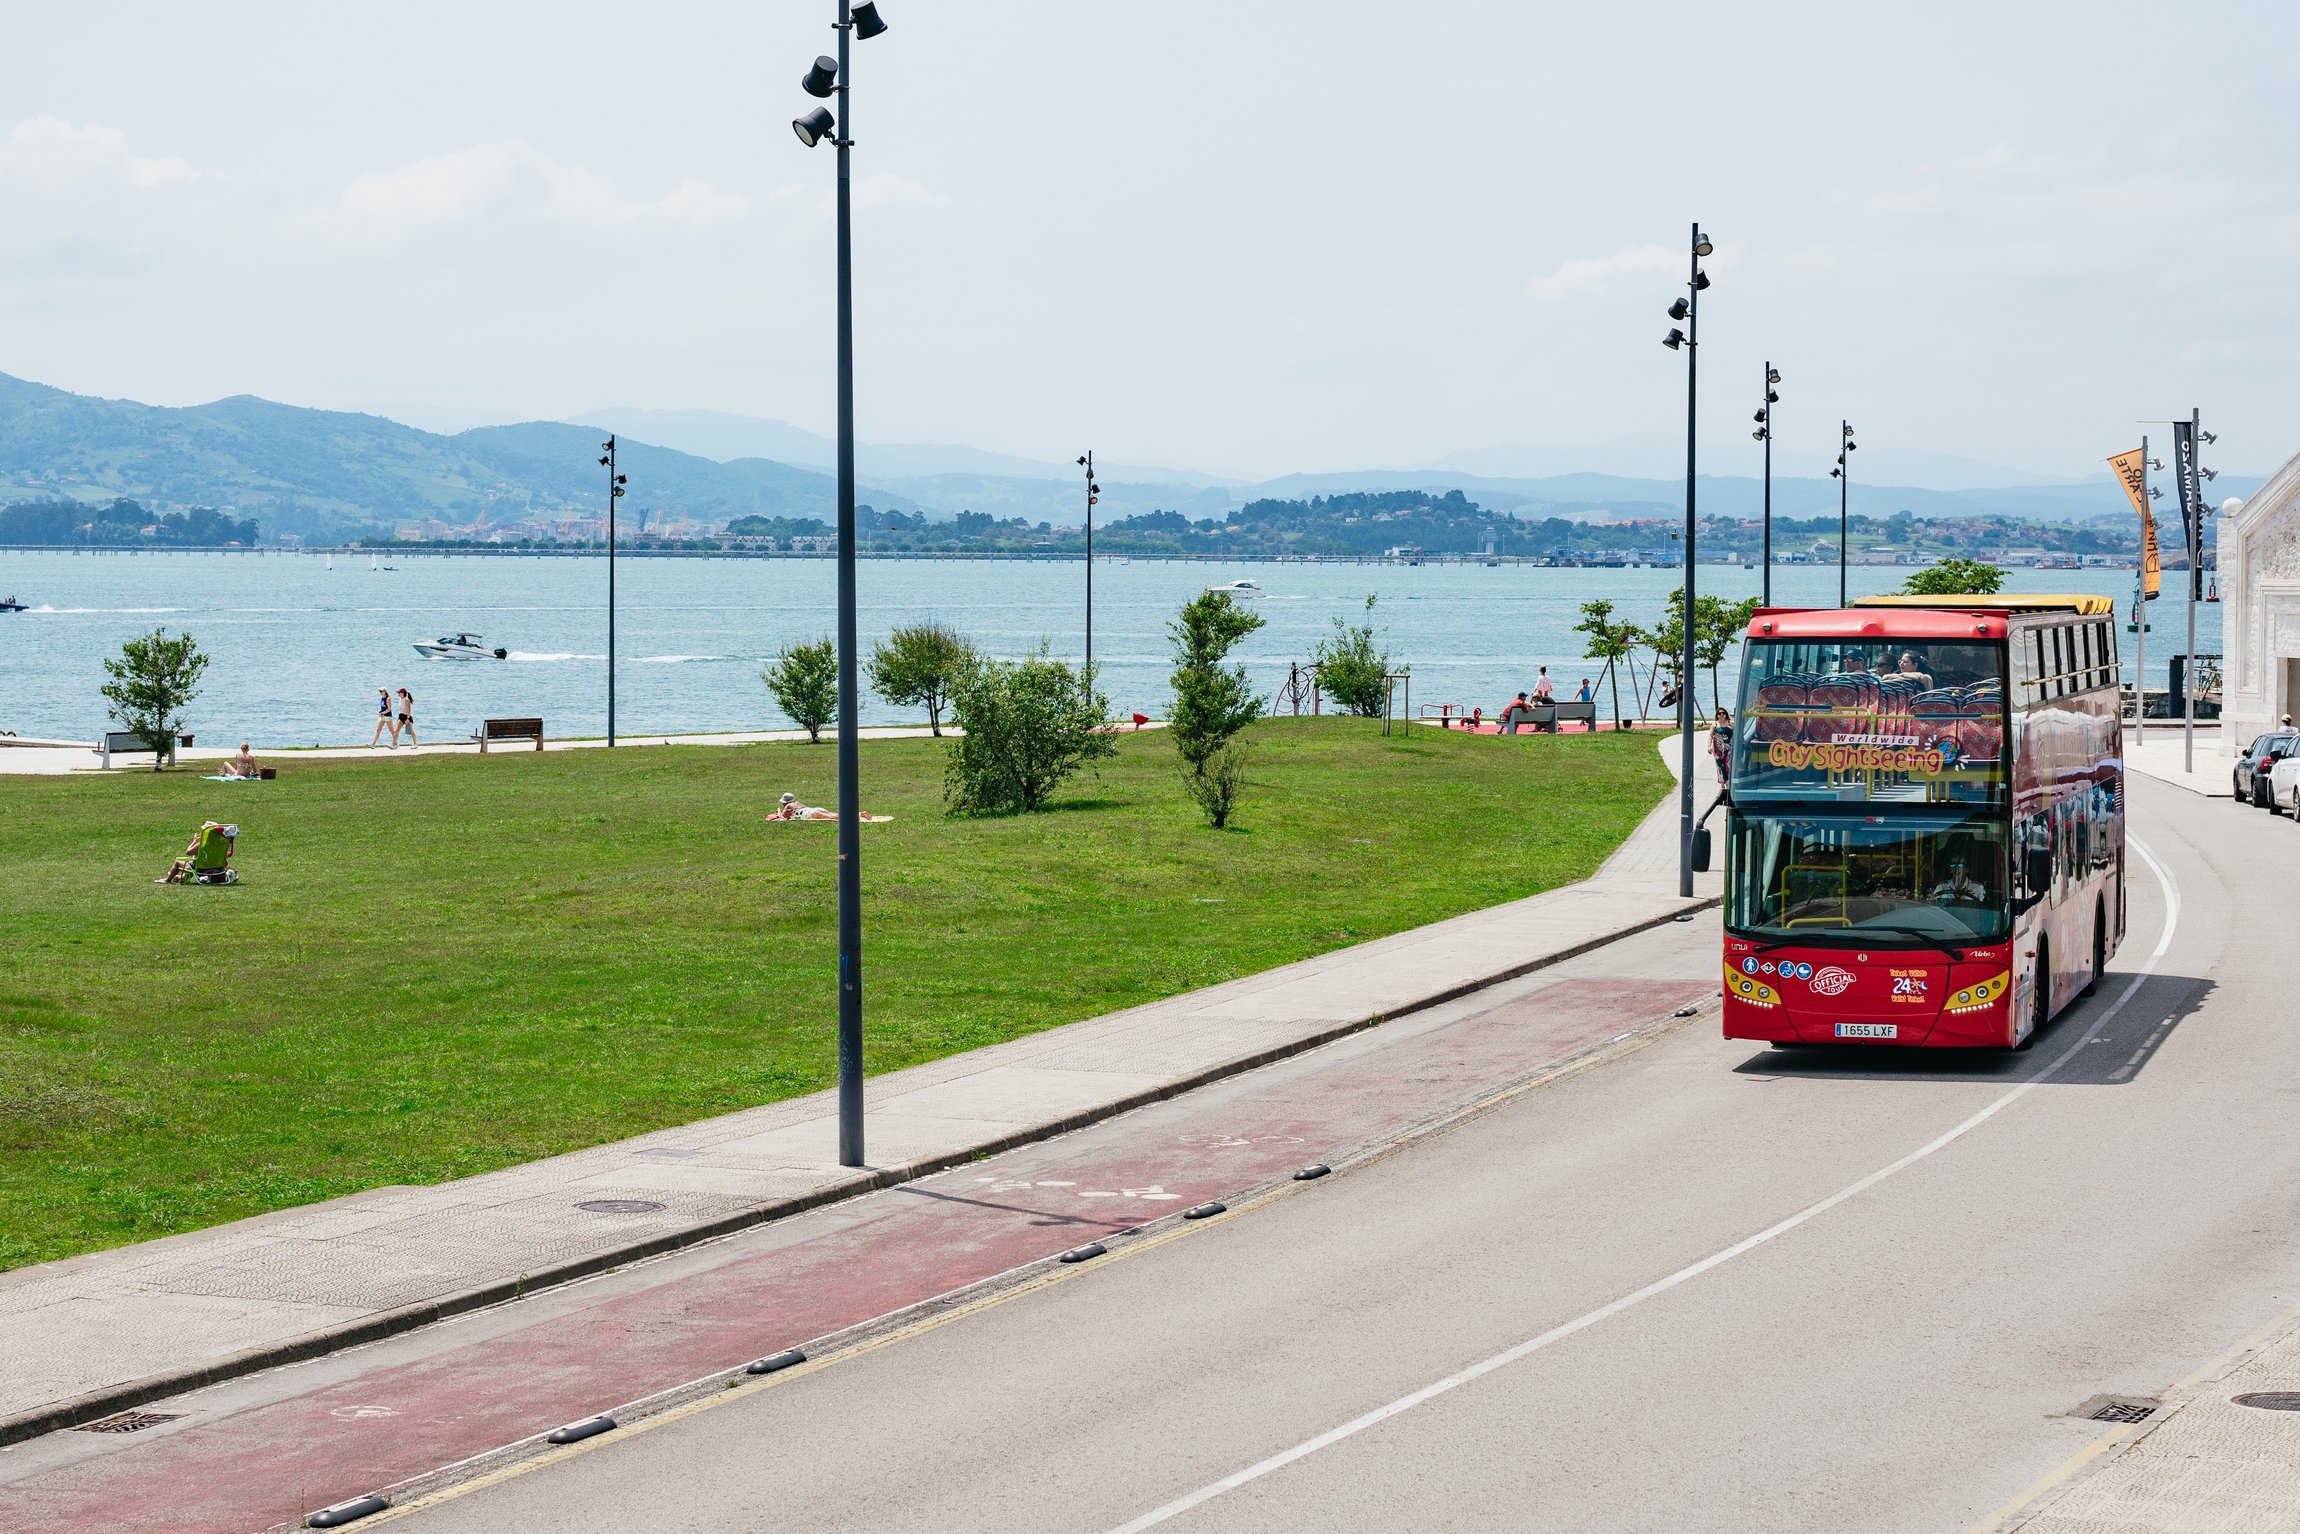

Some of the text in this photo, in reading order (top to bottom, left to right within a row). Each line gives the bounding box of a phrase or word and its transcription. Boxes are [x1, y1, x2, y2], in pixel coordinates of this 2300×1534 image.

[1836, 734, 1915, 745] Worldwide
[1814, 974, 1853, 990] OFFICIAL
[1893, 977, 1910, 994] 24
[1827, 984, 1845, 993] TOUR
[1844, 1025, 1895, 1037] 1655 LXF
